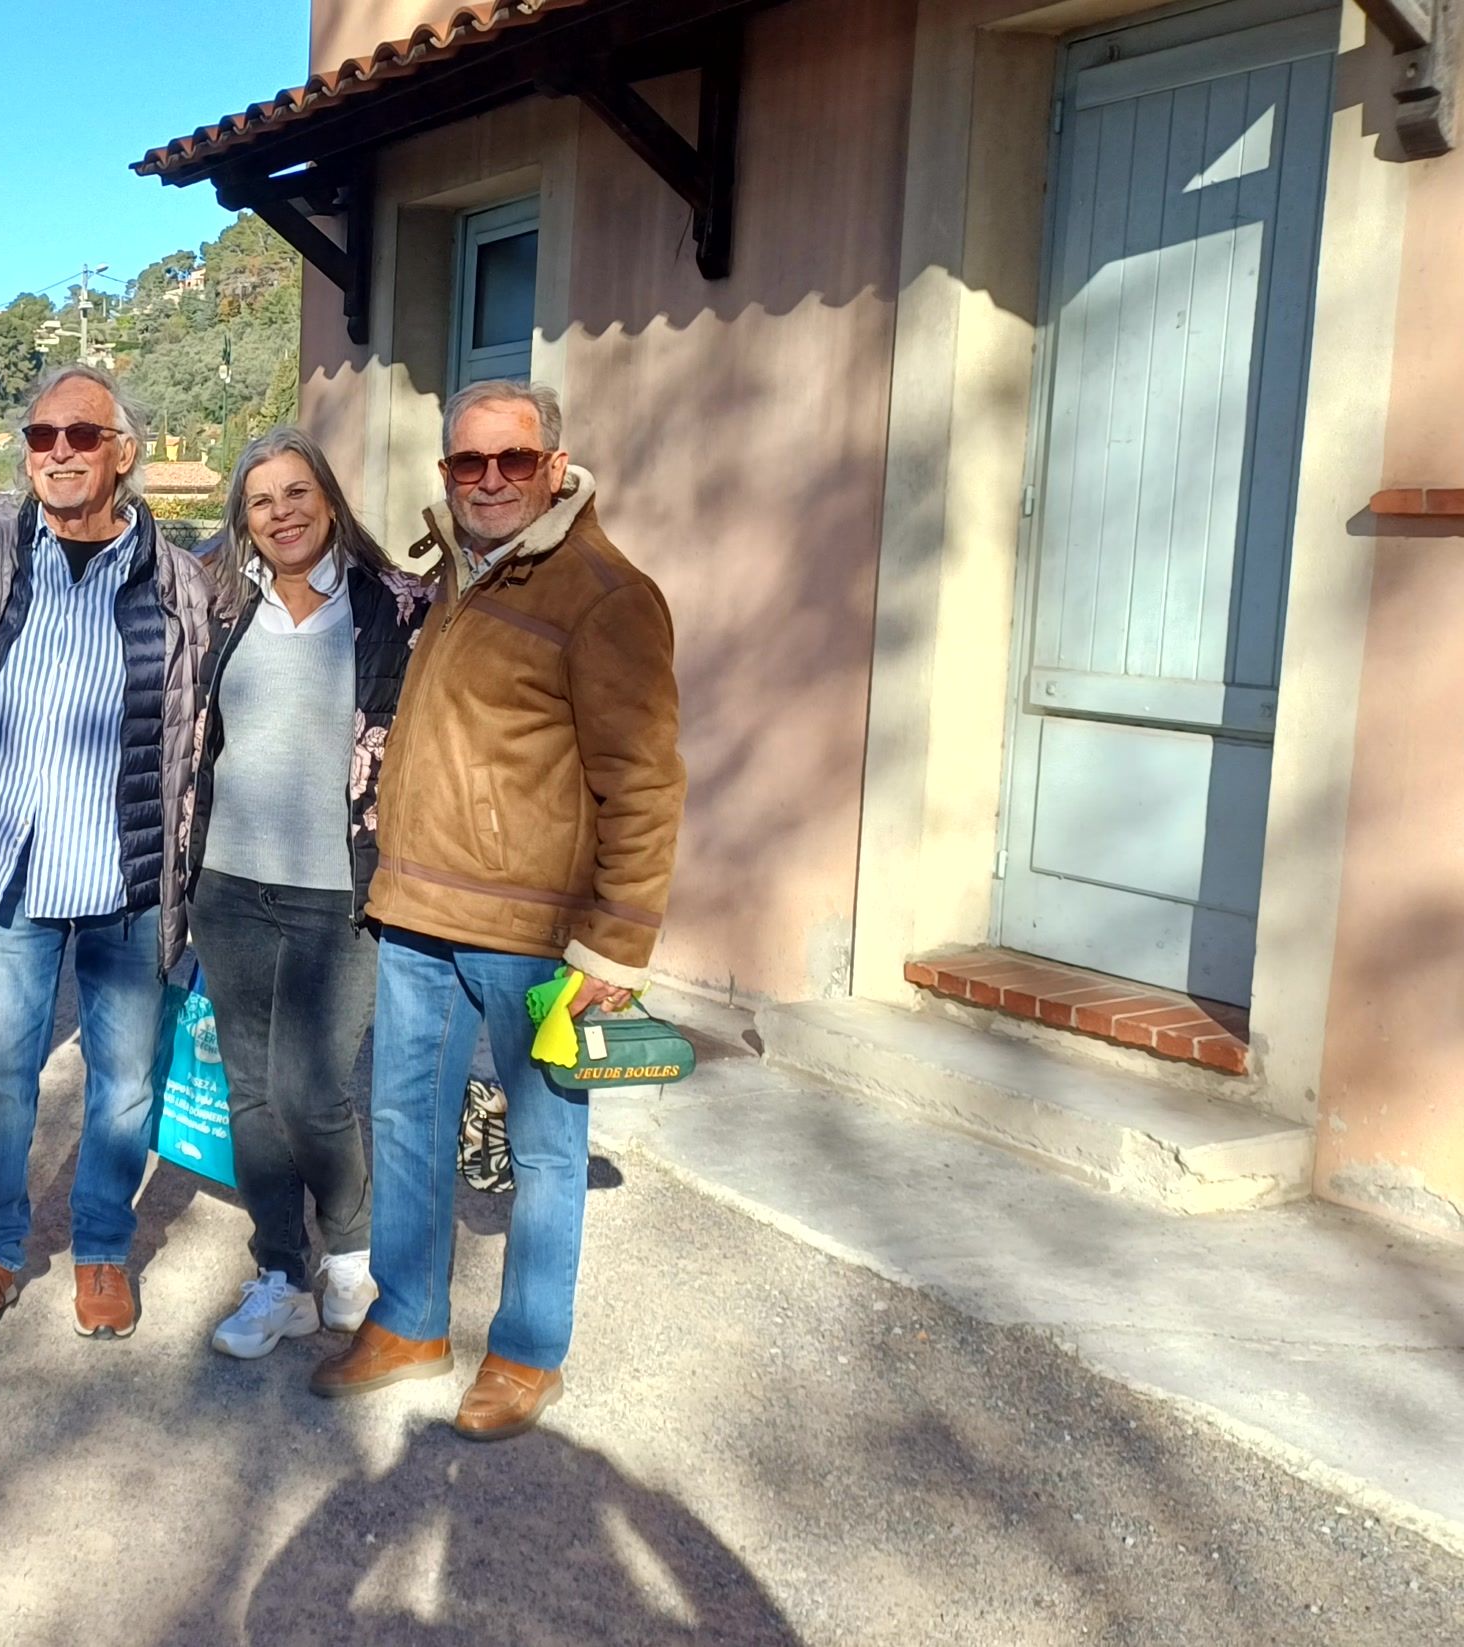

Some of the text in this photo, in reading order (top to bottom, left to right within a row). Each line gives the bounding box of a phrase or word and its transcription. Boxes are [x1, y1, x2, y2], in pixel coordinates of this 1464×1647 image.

[574, 1065, 680, 1080] JEU DE BOULES
